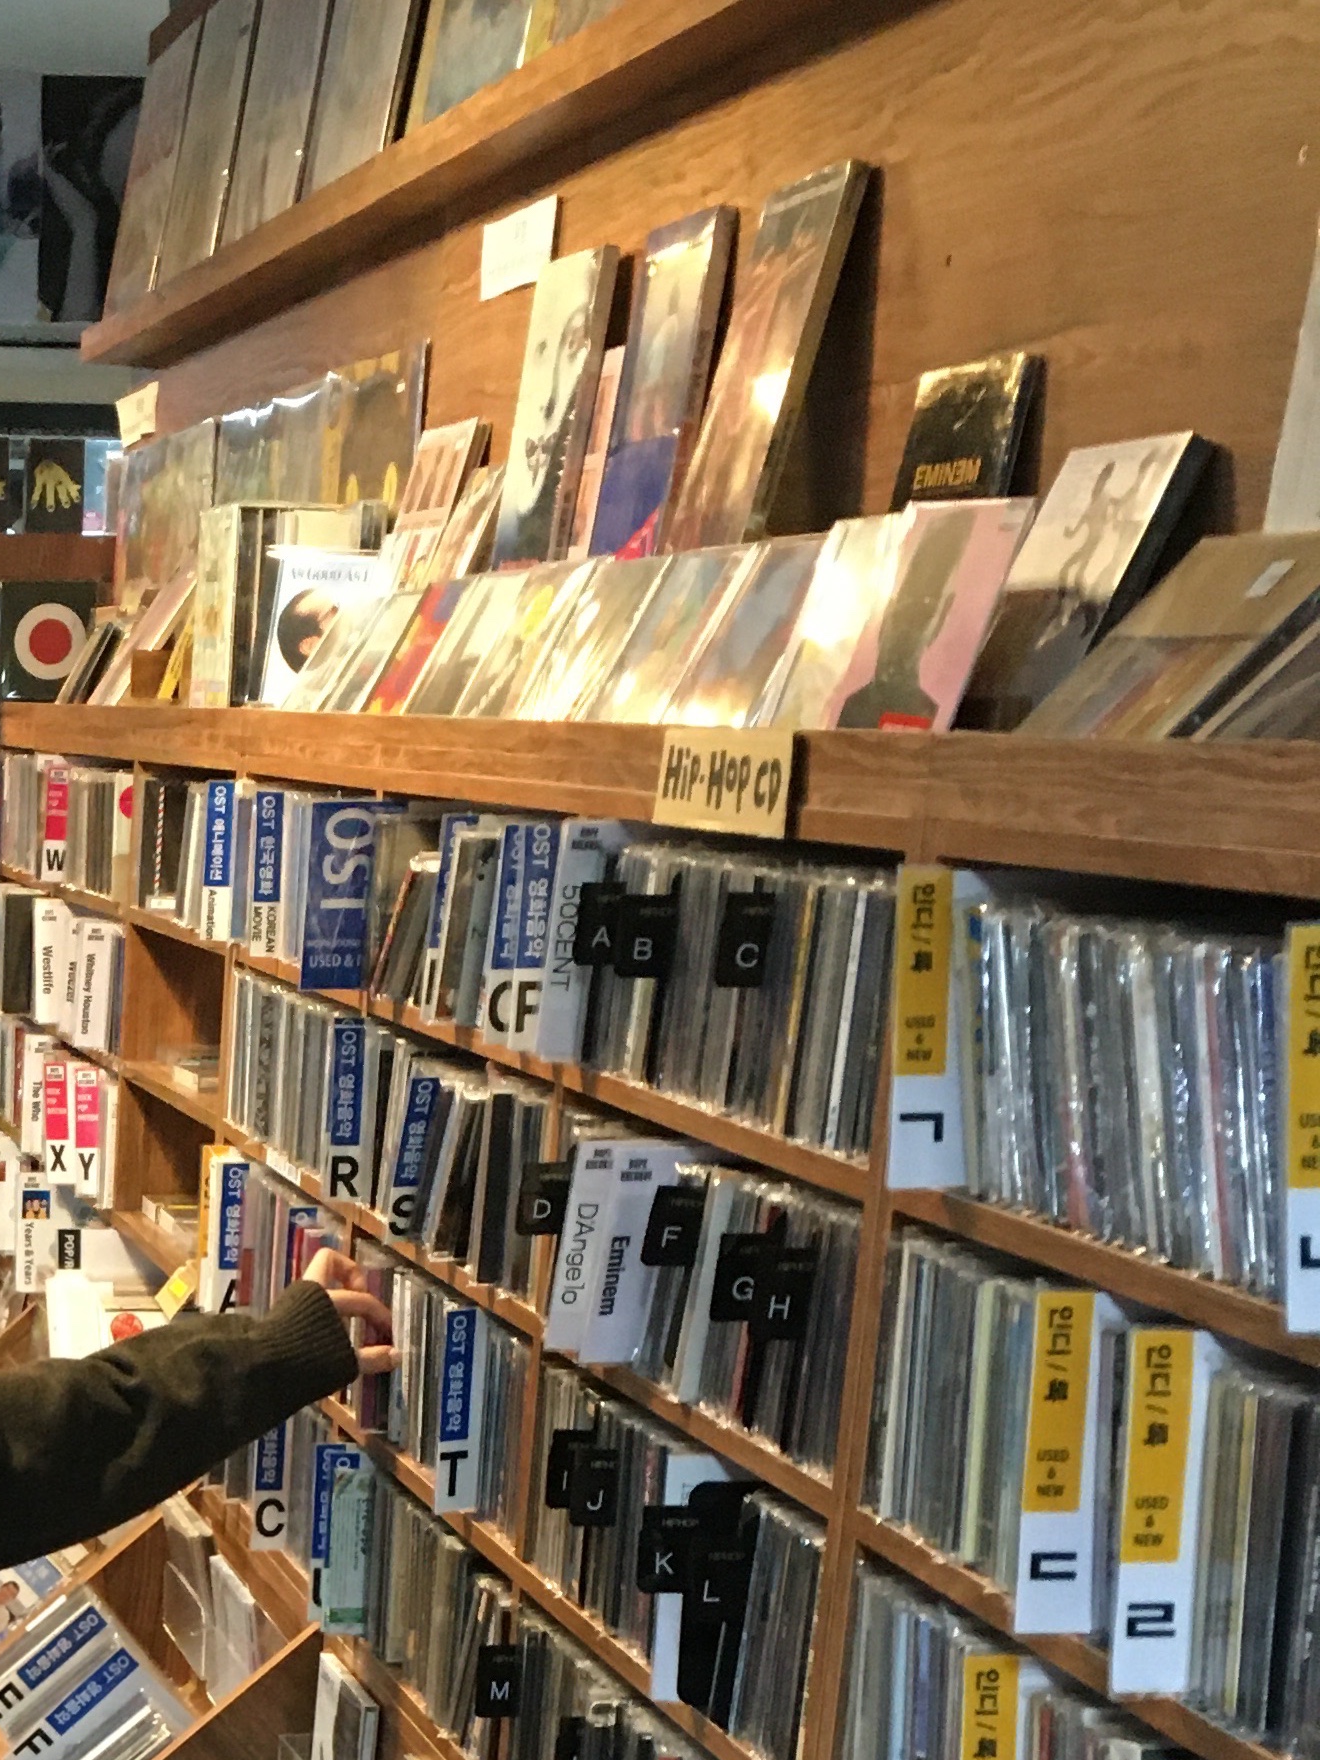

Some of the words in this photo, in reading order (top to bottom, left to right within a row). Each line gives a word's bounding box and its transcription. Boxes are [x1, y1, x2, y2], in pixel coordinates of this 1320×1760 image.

[214, 785, 227, 814] OST
[754, 757, 782, 815] CD
[262, 796, 276, 830] OST
[46, 848, 66, 871] W
[533, 823, 551, 869] OST
[259, 835, 276, 896] 한국영화
[252, 906, 263, 942] MOVIE
[266, 906, 277, 953] KOREAN
[592, 925, 611, 948] A
[633, 937, 653, 961] B
[735, 943, 759, 968] C
[42, 946, 54, 994] Westlife
[82, 953, 96, 993] Whitney
[81, 995, 93, 1034] Houston
[341, 1031, 356, 1067] OST
[32, 1081, 42, 1095] The
[414, 1081, 433, 1115] OST
[31, 1097, 42, 1122] Who
[50, 1144, 67, 1172] X
[78, 1153, 95, 1181] Y
[228, 1167, 243, 1199] OST
[329, 1155, 359, 1197] R
[389, 1194, 416, 1236] S
[533, 1199, 551, 1219] D
[661, 1226, 683, 1248] F
[598, 1235, 631, 1317] Eminem
[732, 1276, 755, 1301] G
[768, 1294, 792, 1321] H
[453, 1315, 468, 1355] OST
[440, 1450, 469, 1497] T
[587, 1490, 604, 1511] J
[256, 1498, 285, 1537] C
[655, 1552, 674, 1575] K
[703, 1580, 720, 1602] L
[67, 1613, 100, 1643] OST
[100, 1655, 131, 1683] OST
[490, 1681, 510, 1701] M
[13, 1728, 54, 1758] F
